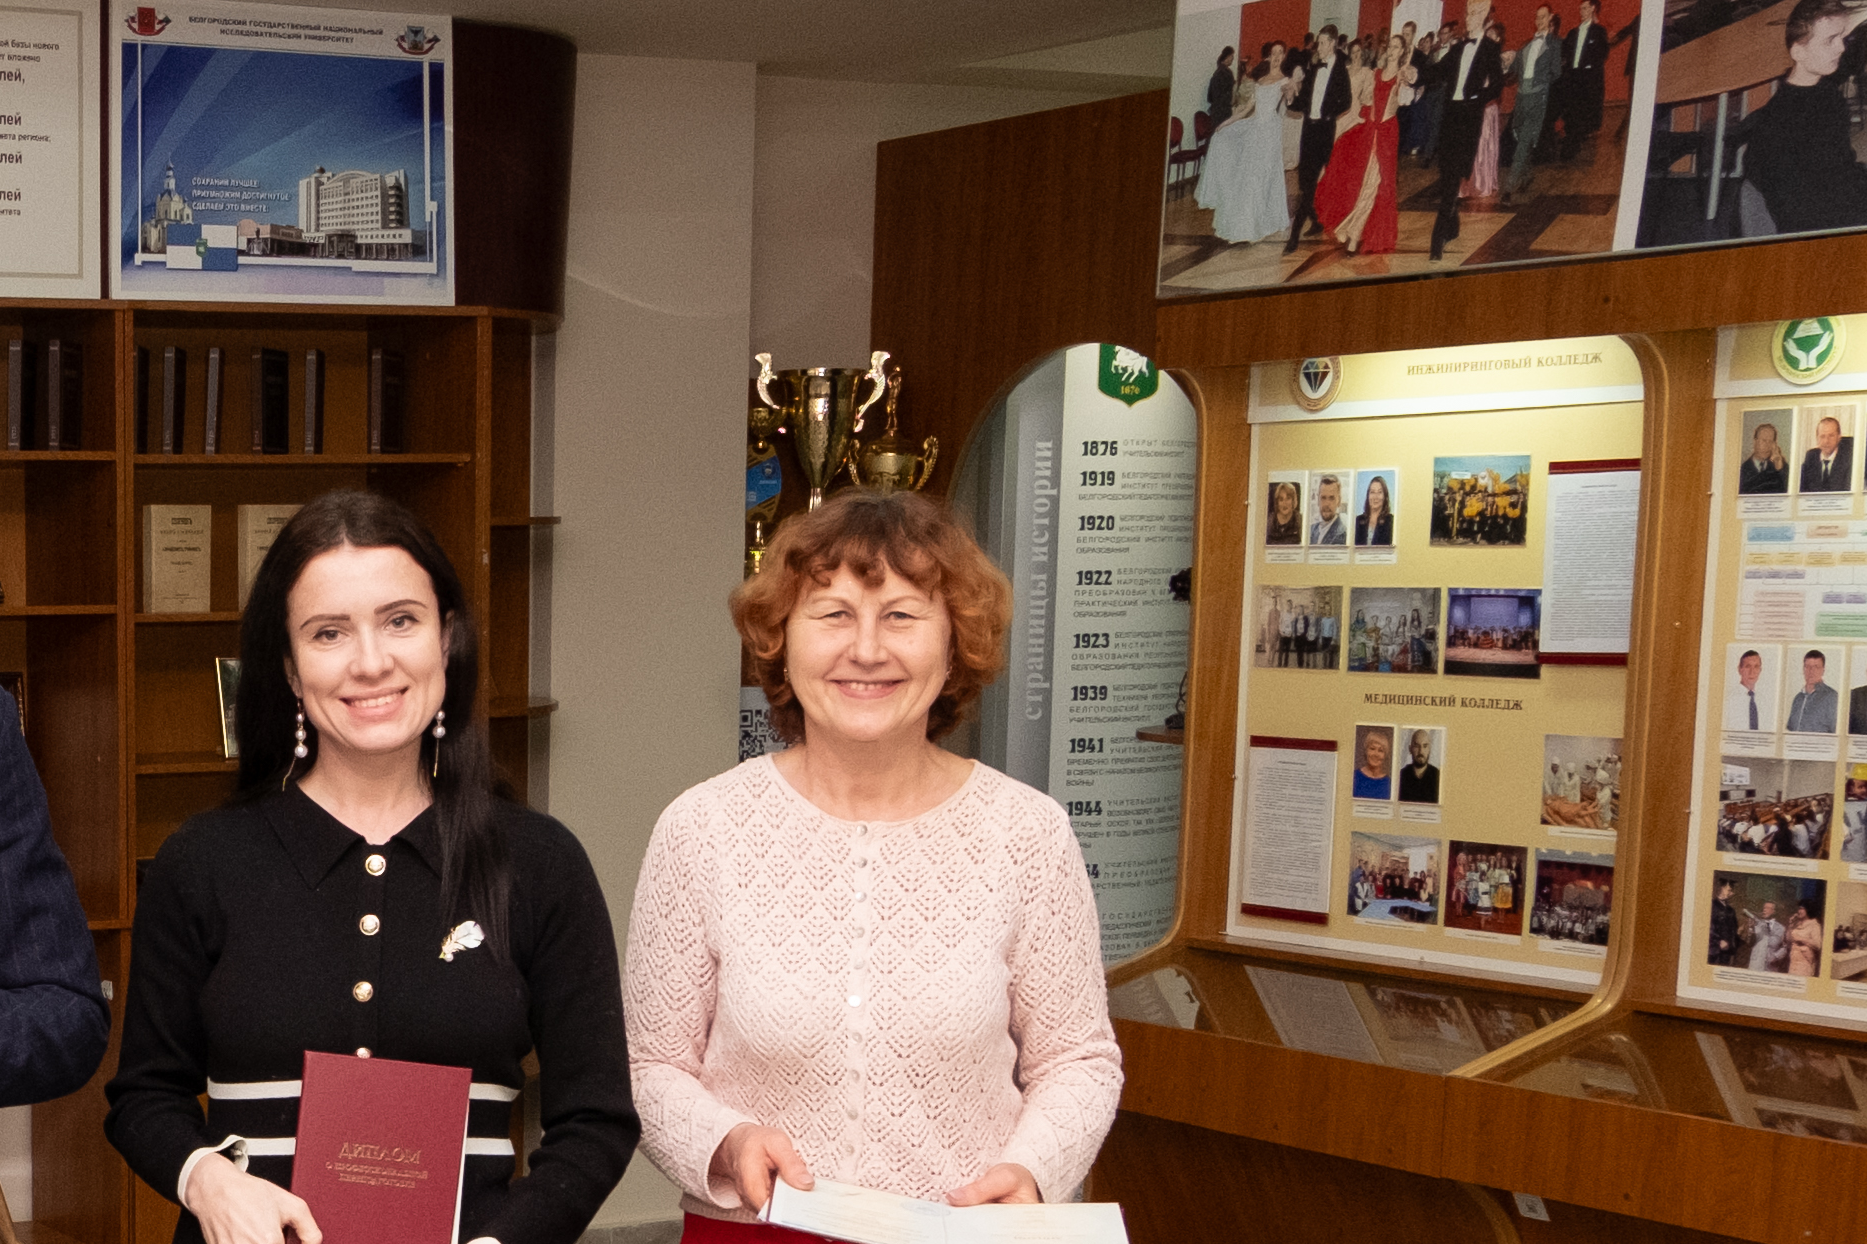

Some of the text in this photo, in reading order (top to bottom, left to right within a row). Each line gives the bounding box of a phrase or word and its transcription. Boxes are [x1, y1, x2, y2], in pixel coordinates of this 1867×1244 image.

[1536, 351, 1603, 368] КОЛЛЕДЖ
[1082, 440, 1118, 456] 1876
[1080, 471, 1115, 486] 1919
[1078, 515, 1116, 531] 1920
[1076, 570, 1113, 586] 1922
[1073, 633, 1110, 649] 1923
[1071, 685, 1108, 701] 1939
[1364, 693, 1523, 710] МЕДИЦИНСКИЙ КОЛЛЕДЖ
[1069, 737, 1104, 753] 1941
[1066, 801, 1103, 816] 1944
[338, 1141, 422, 1165] ДИПЛОМ
